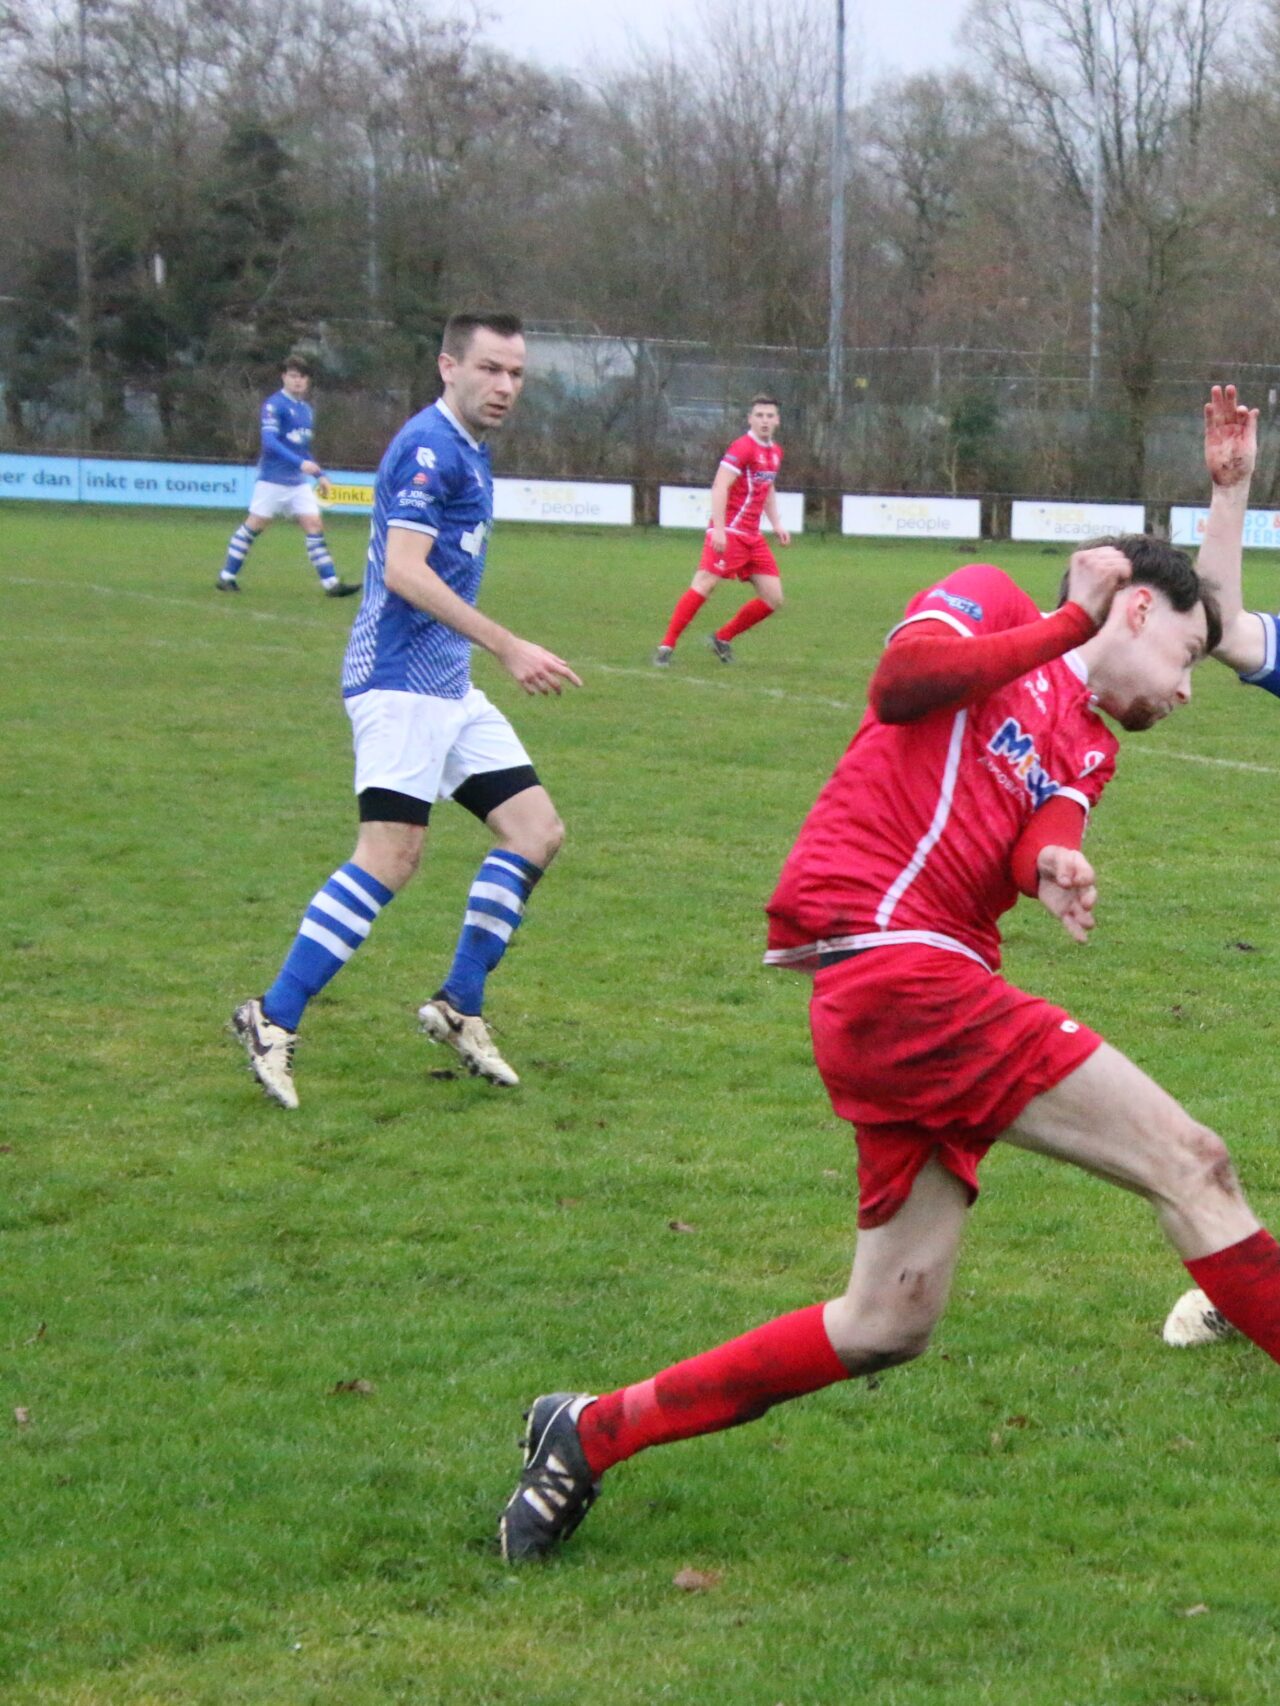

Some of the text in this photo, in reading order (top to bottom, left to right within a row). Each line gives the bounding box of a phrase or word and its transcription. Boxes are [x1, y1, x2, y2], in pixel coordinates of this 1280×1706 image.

[0, 469, 238, 493] er dan inkt en toners!
[542, 500, 601, 518] people
[896, 516, 952, 533] people
